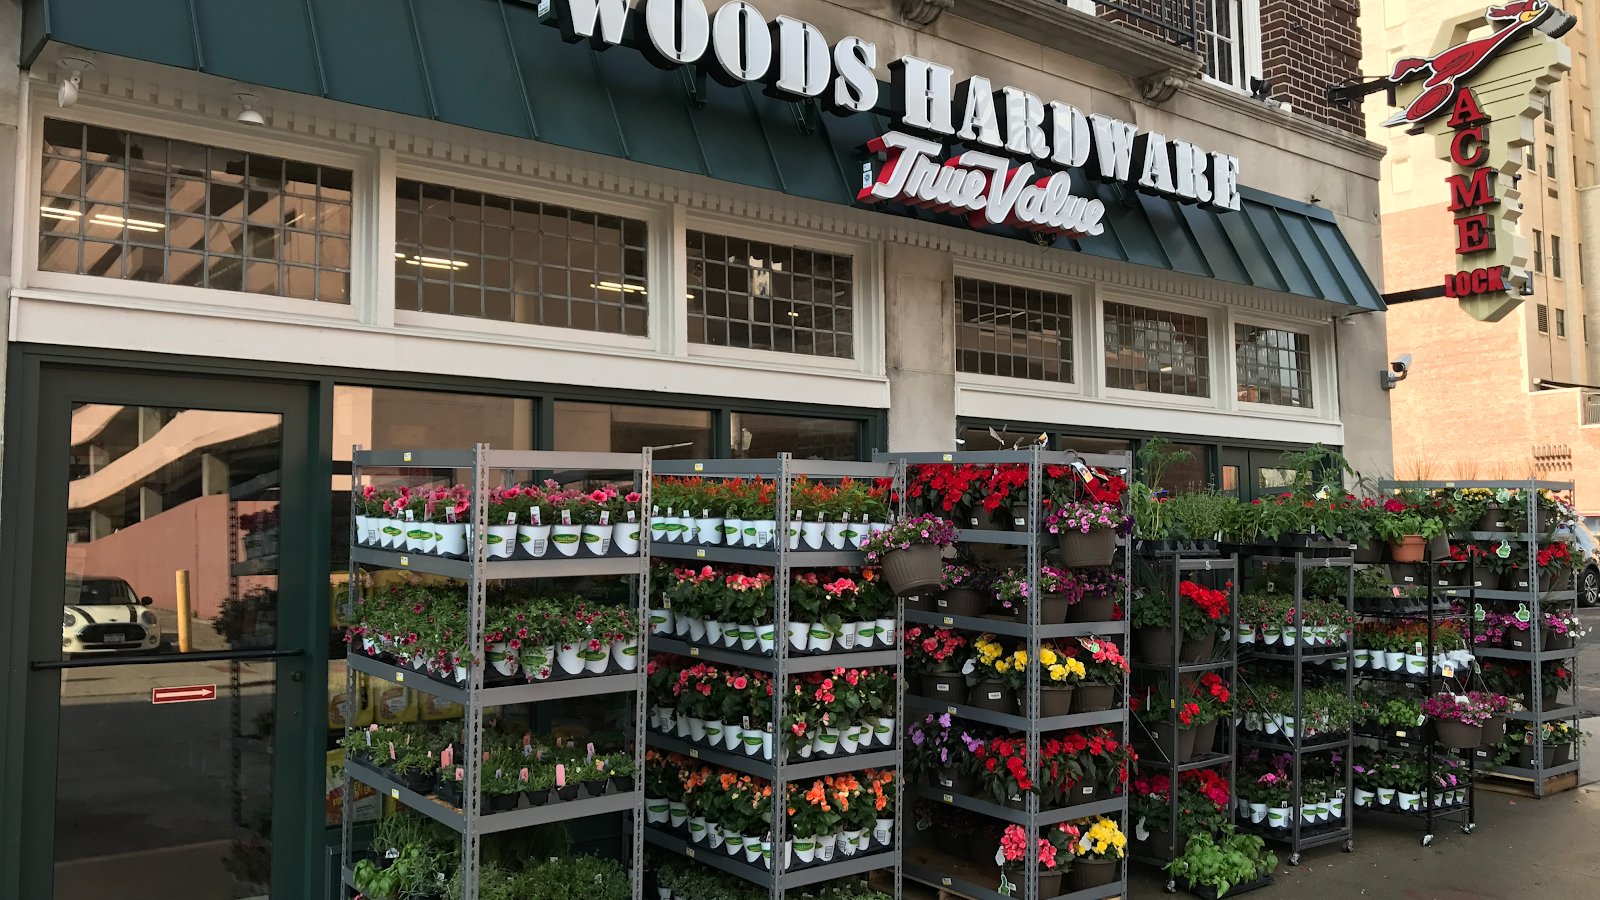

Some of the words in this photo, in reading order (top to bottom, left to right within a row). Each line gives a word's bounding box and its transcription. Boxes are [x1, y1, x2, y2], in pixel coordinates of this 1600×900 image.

[564, 0, 879, 112] WOODS
[901, 54, 1241, 212] HARDWARE
[1445, 86, 1500, 255] ACME
[872, 131, 987, 210] True
[958, 150, 1105, 236] Value
[1445, 265, 1505, 298] LOCK
